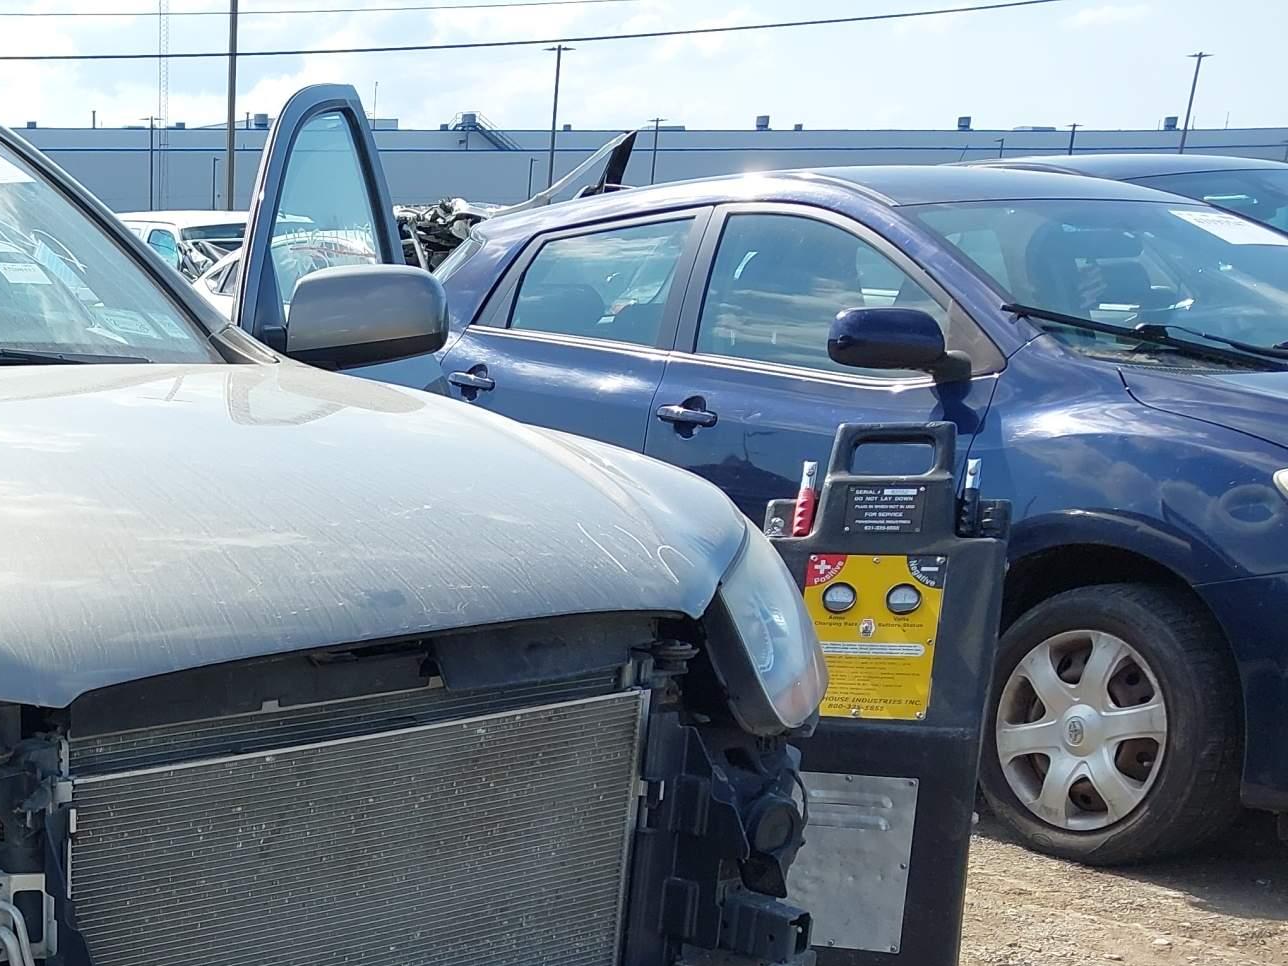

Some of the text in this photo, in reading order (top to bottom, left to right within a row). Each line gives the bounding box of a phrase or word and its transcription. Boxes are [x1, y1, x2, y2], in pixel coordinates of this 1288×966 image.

[814, 560, 844, 585] Positive
[909, 560, 936, 586] Negative
[851, 696, 903, 704] INDUSTRIES
